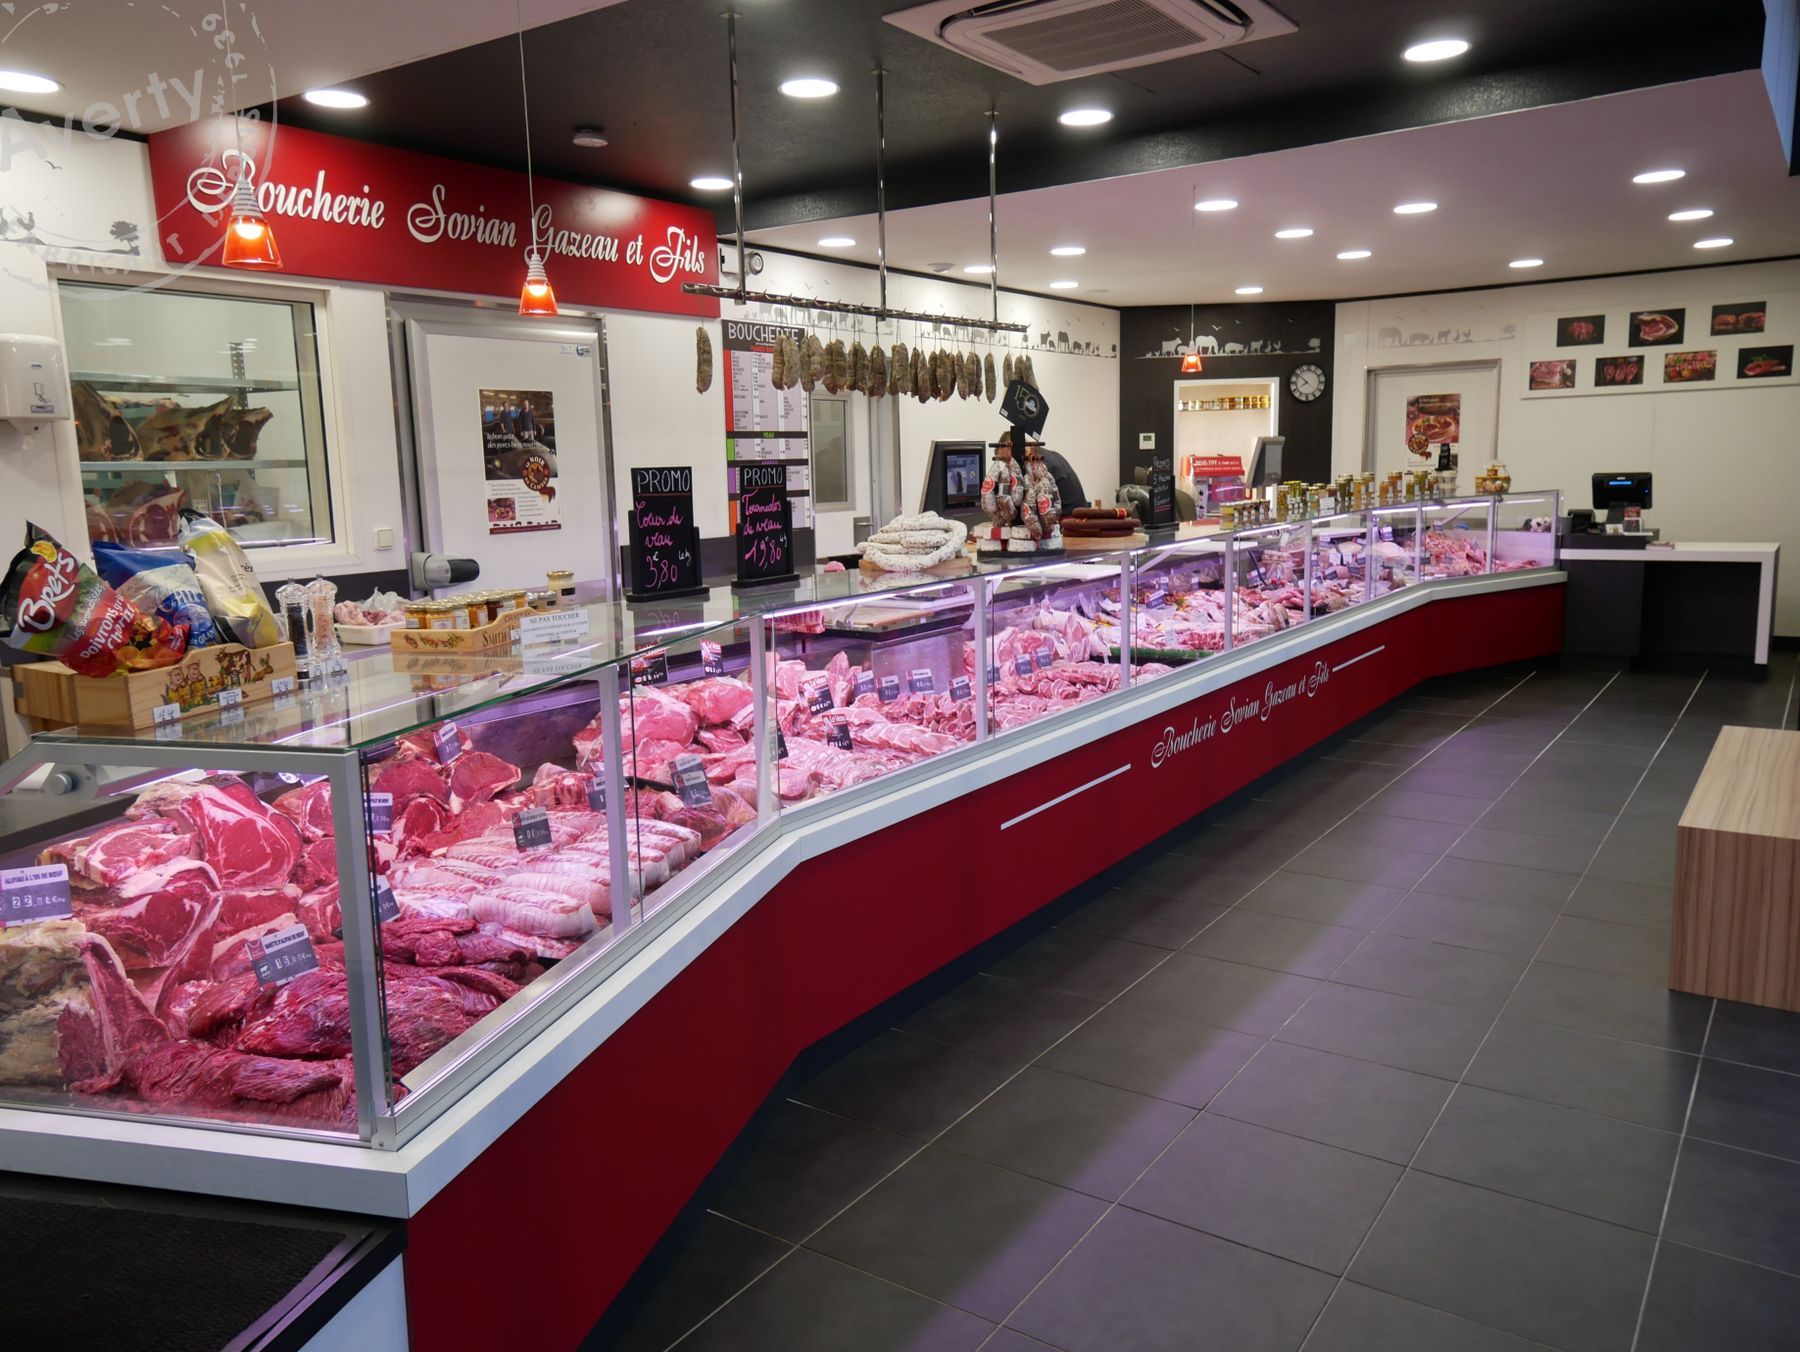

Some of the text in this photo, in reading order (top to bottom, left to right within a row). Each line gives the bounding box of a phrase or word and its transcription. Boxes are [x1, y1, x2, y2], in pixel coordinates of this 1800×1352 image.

[186, 149, 705, 284] Boucherie Sovian Gazeau et Fils
[638, 469, 691, 493] PROMO
[744, 466, 783, 487] PROMO
[743, 516, 755, 536] de
[18, 551, 76, 631] Brets
[1151, 660, 1330, 769] Boucherie Sovian Gazeau et Fils
